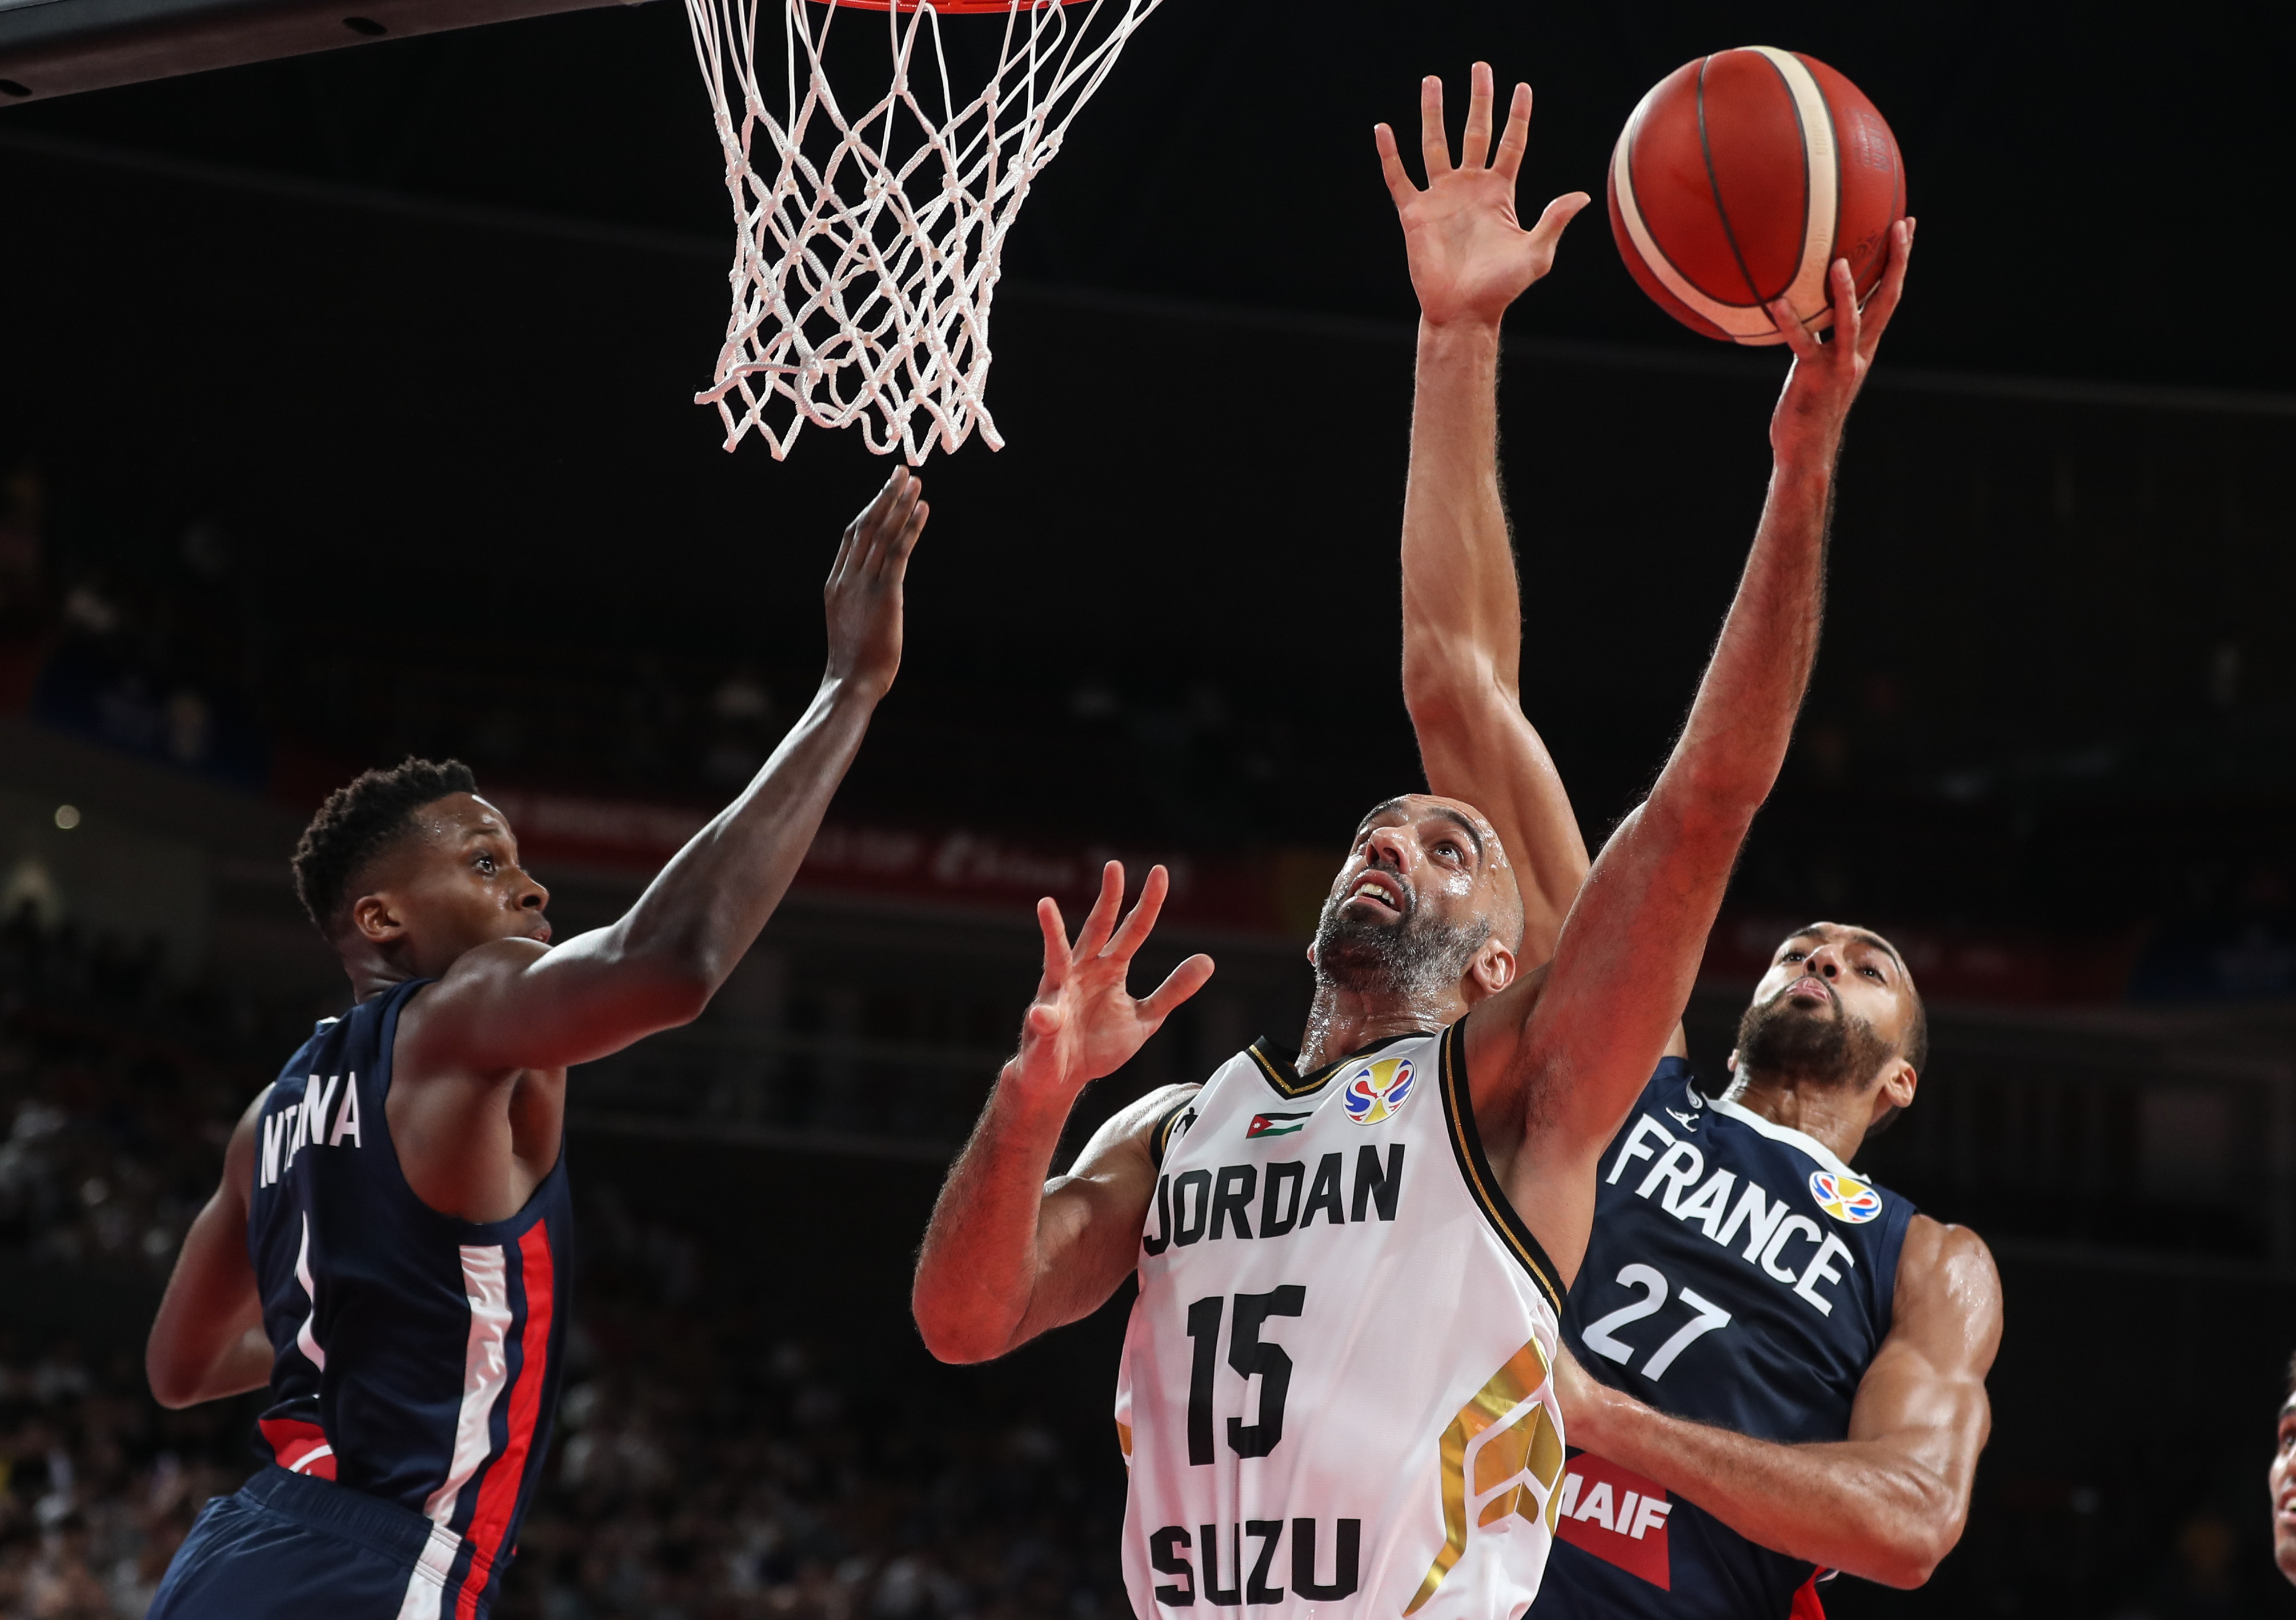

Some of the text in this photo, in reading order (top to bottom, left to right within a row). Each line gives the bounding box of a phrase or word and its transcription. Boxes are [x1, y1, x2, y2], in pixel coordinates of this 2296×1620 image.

[1143, 1143, 1405, 1257] JORDAN
[1605, 1113, 1855, 1318] FRANCE
[1187, 1284, 1307, 1466] 15
[1581, 1263, 1732, 1382] 27
[1149, 1517, 1361, 1607] SUZU
